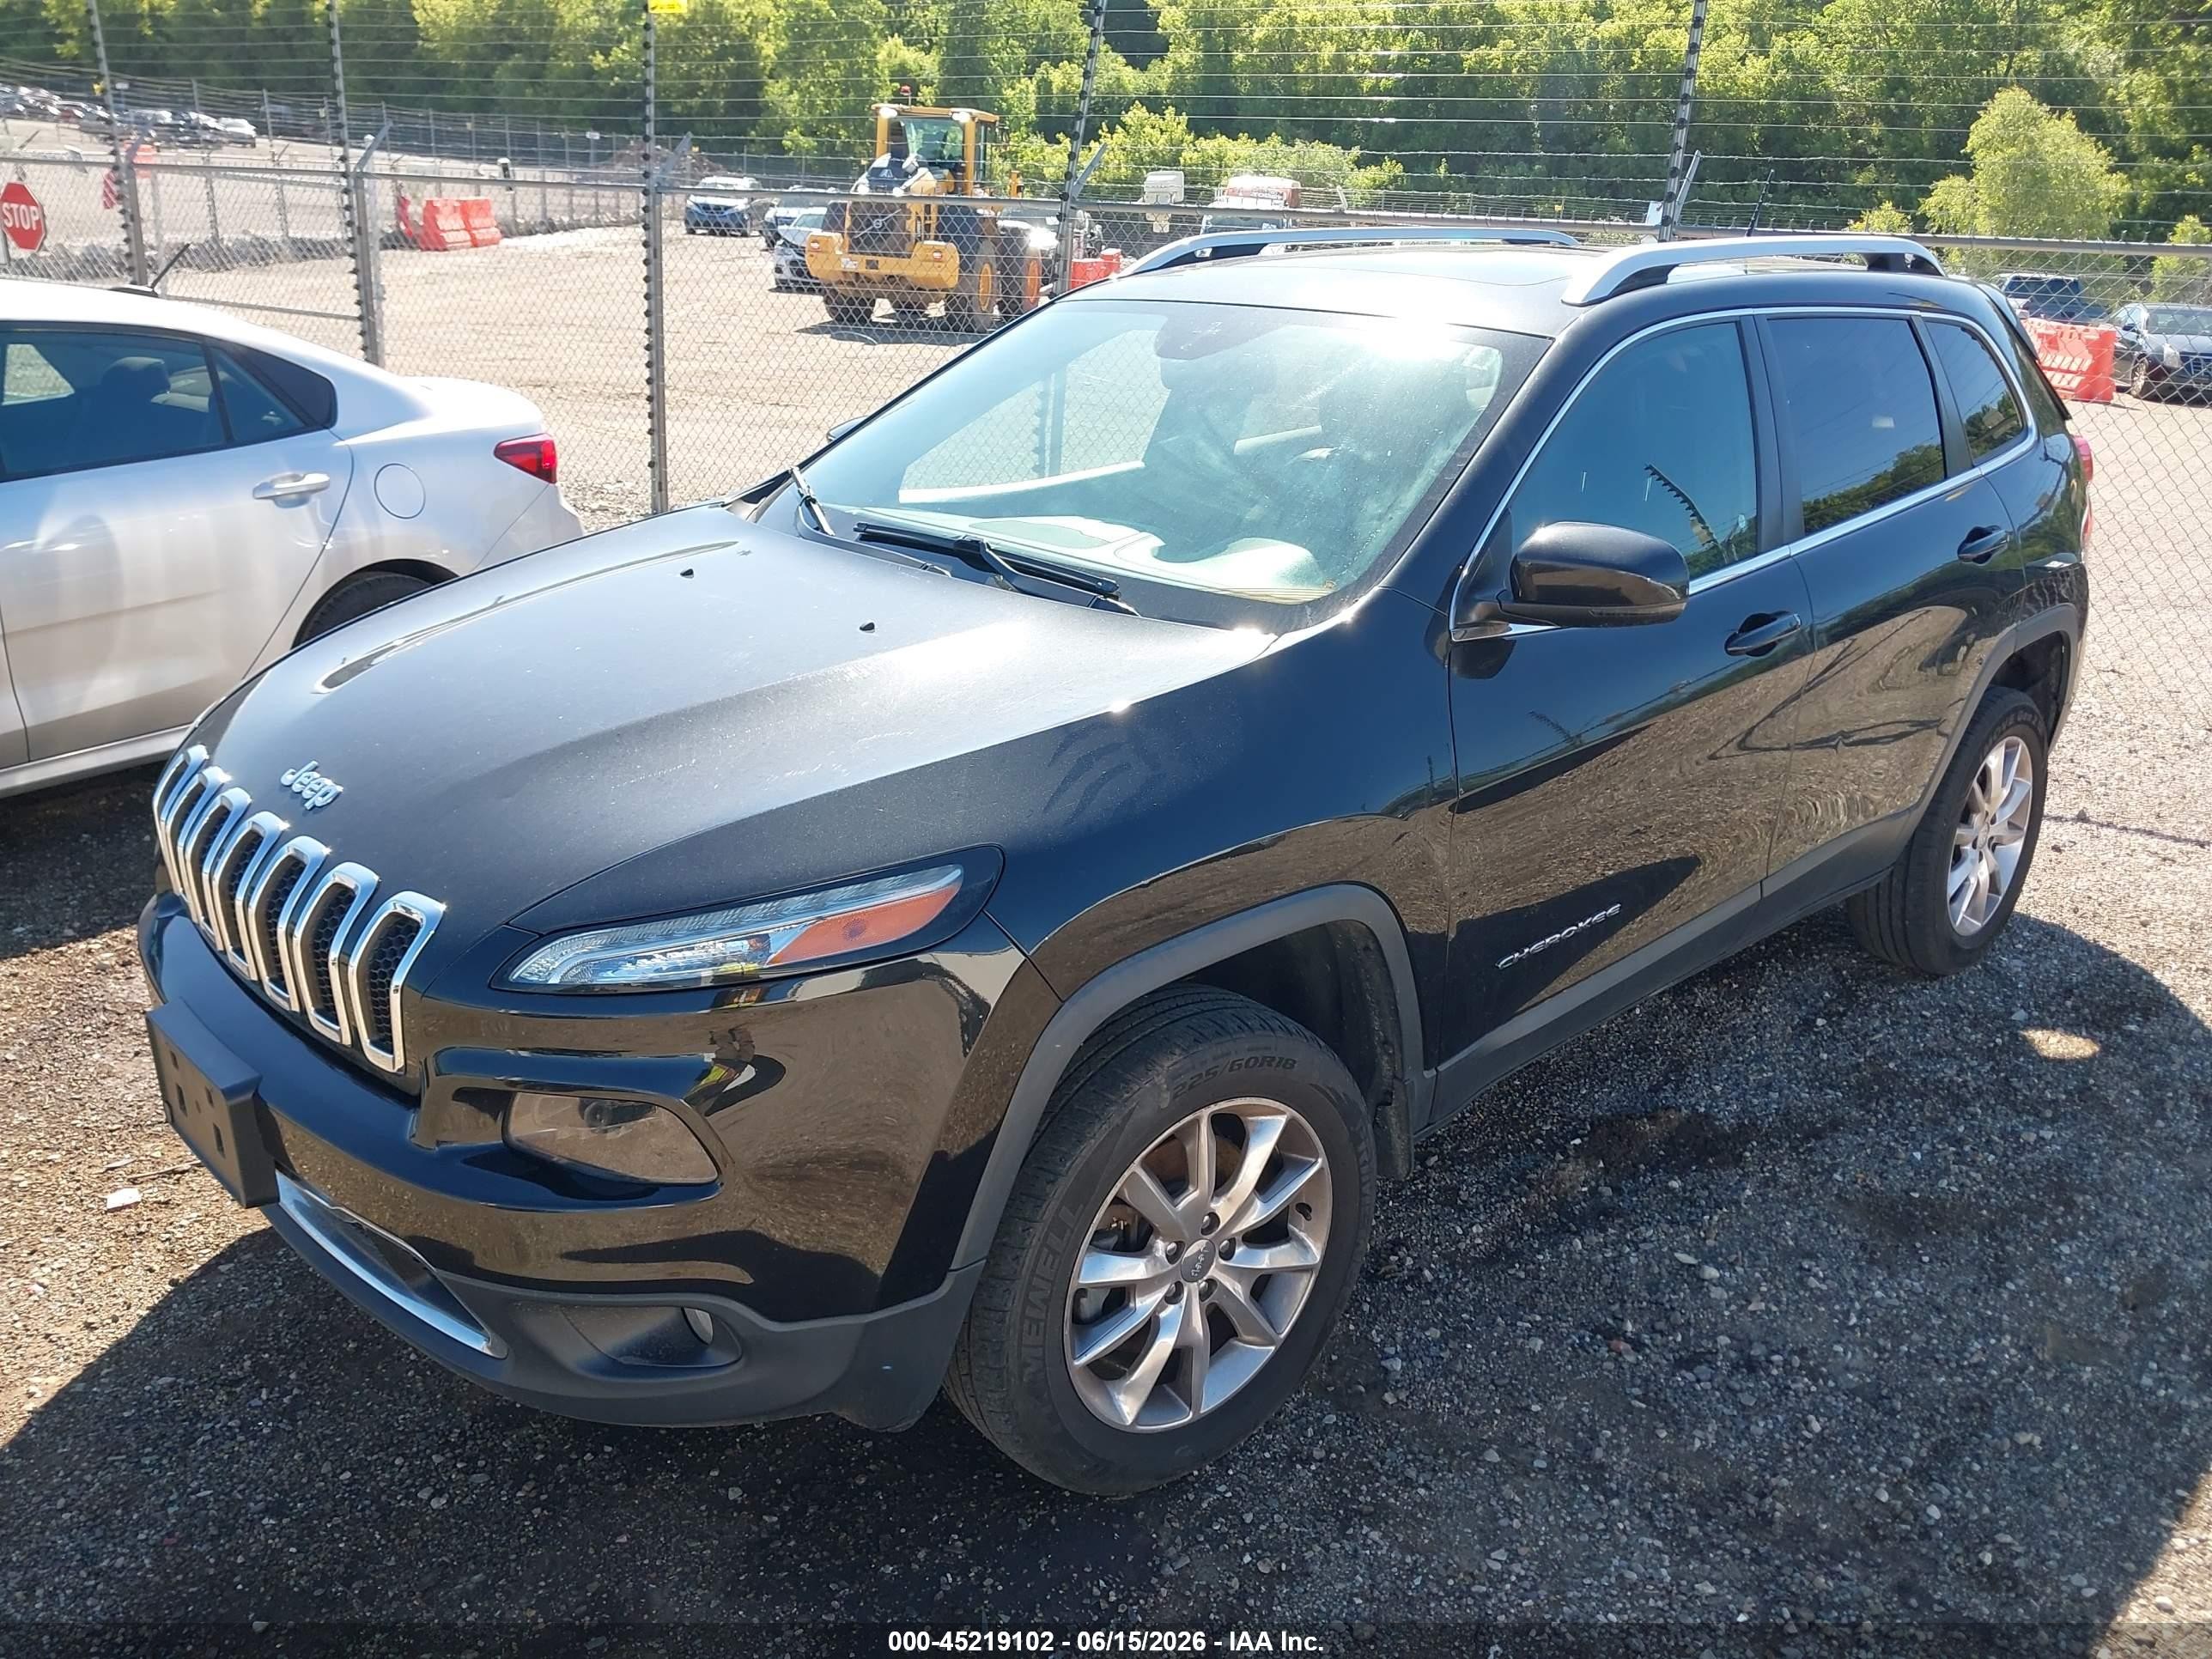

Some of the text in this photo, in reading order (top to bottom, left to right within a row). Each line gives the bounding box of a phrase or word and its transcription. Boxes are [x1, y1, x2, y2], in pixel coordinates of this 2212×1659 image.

[3, 202, 40, 231] STOP
[280, 760, 343, 810] Jeep
[1494, 903, 1621, 969] CHEROKEE
[1172, 1055, 1297, 1100] 225/60R18
